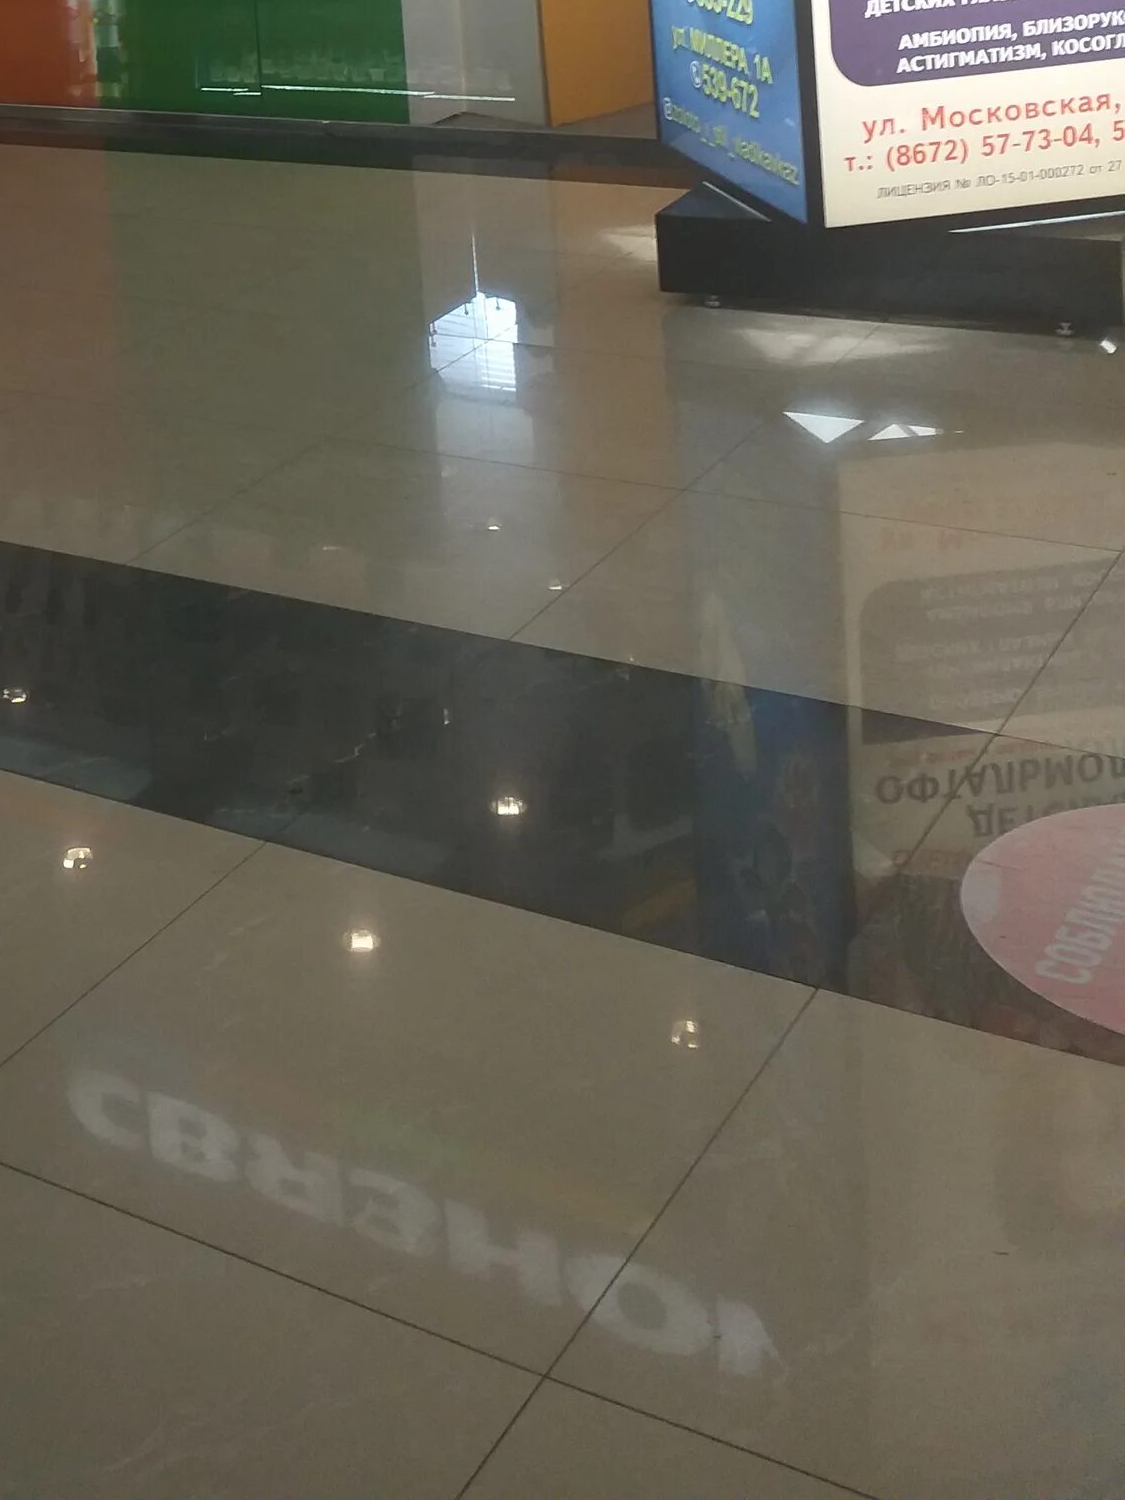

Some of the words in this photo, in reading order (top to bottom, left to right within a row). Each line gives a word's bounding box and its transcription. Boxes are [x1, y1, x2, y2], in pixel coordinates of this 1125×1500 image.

[898, 23, 1018, 51] АМБИОПИЯ,
[1022, 10, 1125, 37] БЛИЗОРУК
[896, 45, 1047, 74] АСТИГМАТИЗМ,
[1052, 32, 1125, 57] КОСОГЛ
[862, 117, 907, 143] ул.
[921, 92, 1122, 131] Московская,
[886, 139, 969, 172] (8672)
[981, 123, 1100, 157] 57-73-04,
[1113, 120, 1125, 142] 5
[877, 179, 951, 198] ЛИЦЕНЗИЯ
[1089, 164, 1103, 175] от
